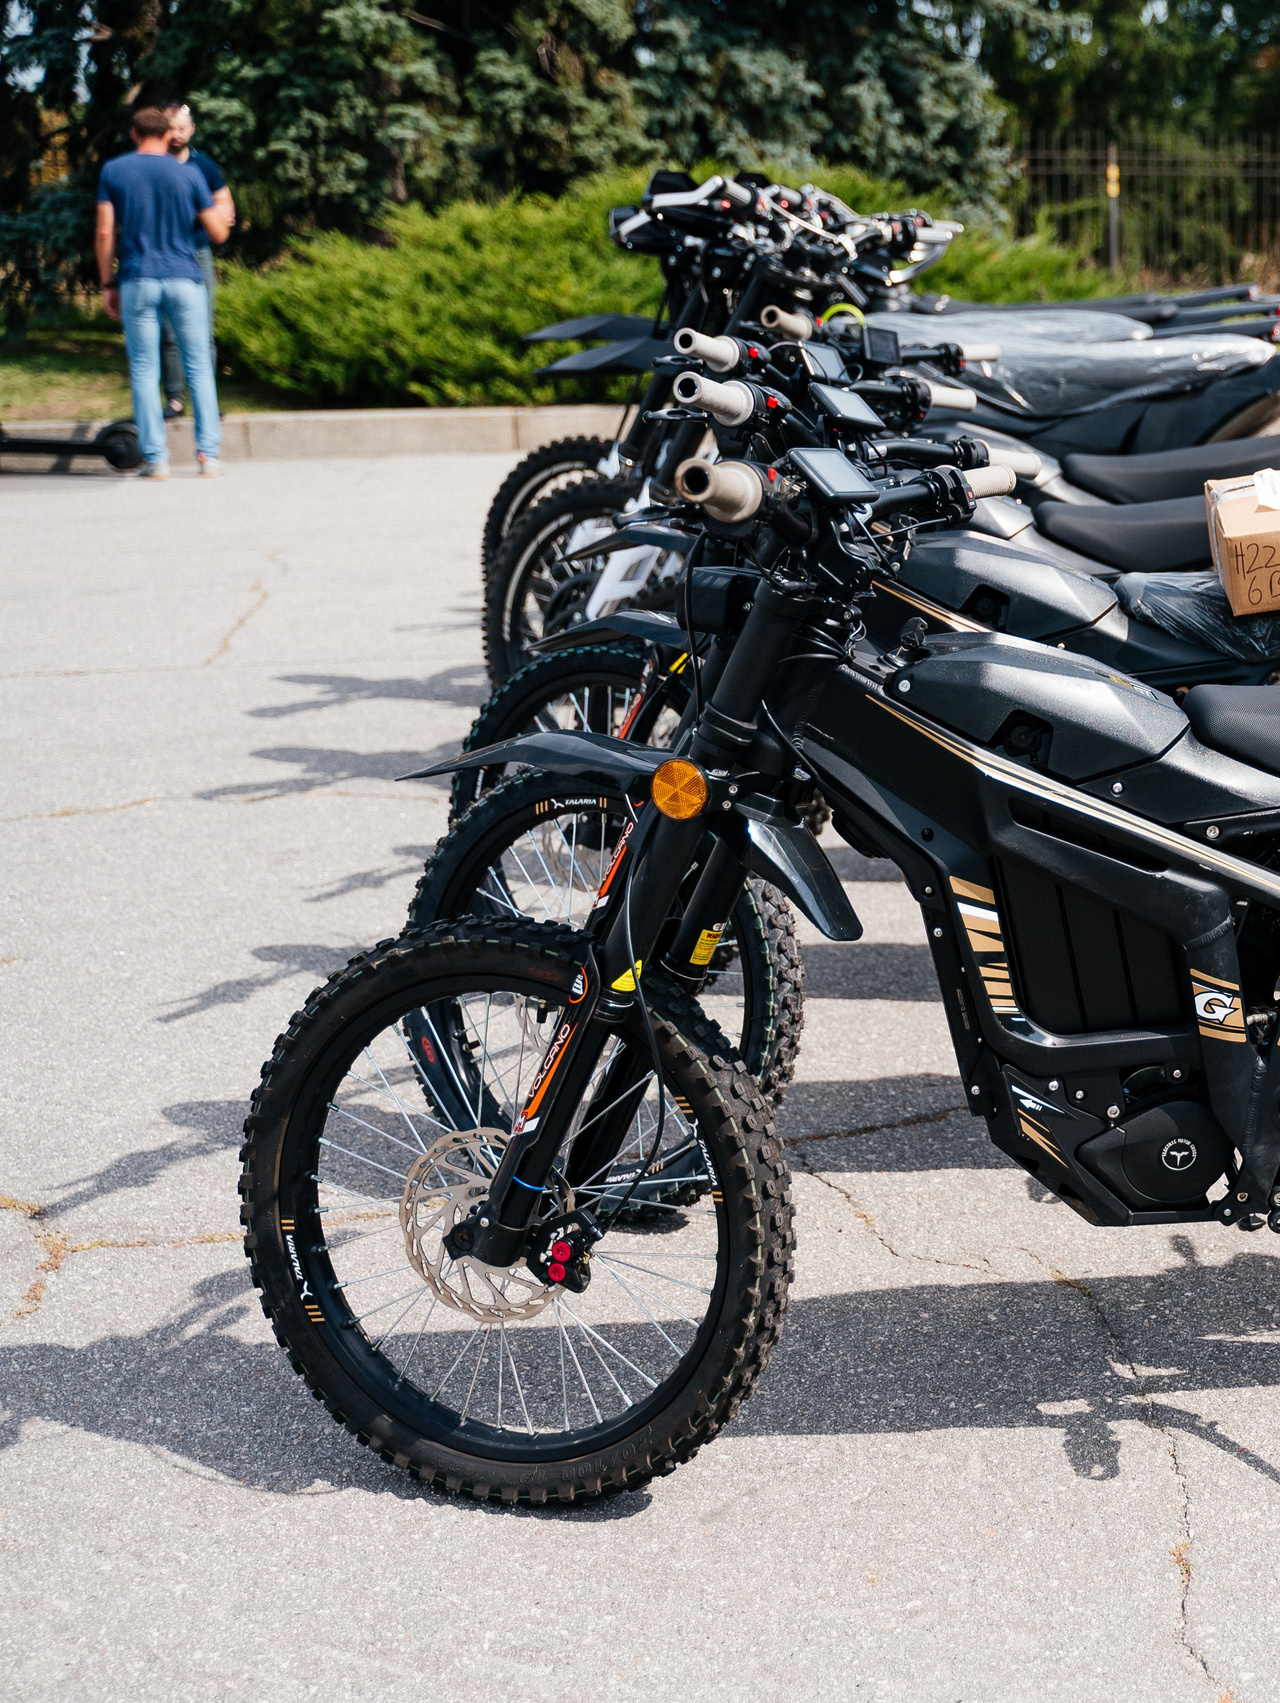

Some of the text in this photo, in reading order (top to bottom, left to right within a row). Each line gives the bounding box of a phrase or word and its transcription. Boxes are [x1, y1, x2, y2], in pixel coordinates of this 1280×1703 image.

[529, 1024, 571, 1098] VOLCANO
[698, 1139, 718, 1186] TALARIA
[285, 1234, 304, 1281] TALARIA
